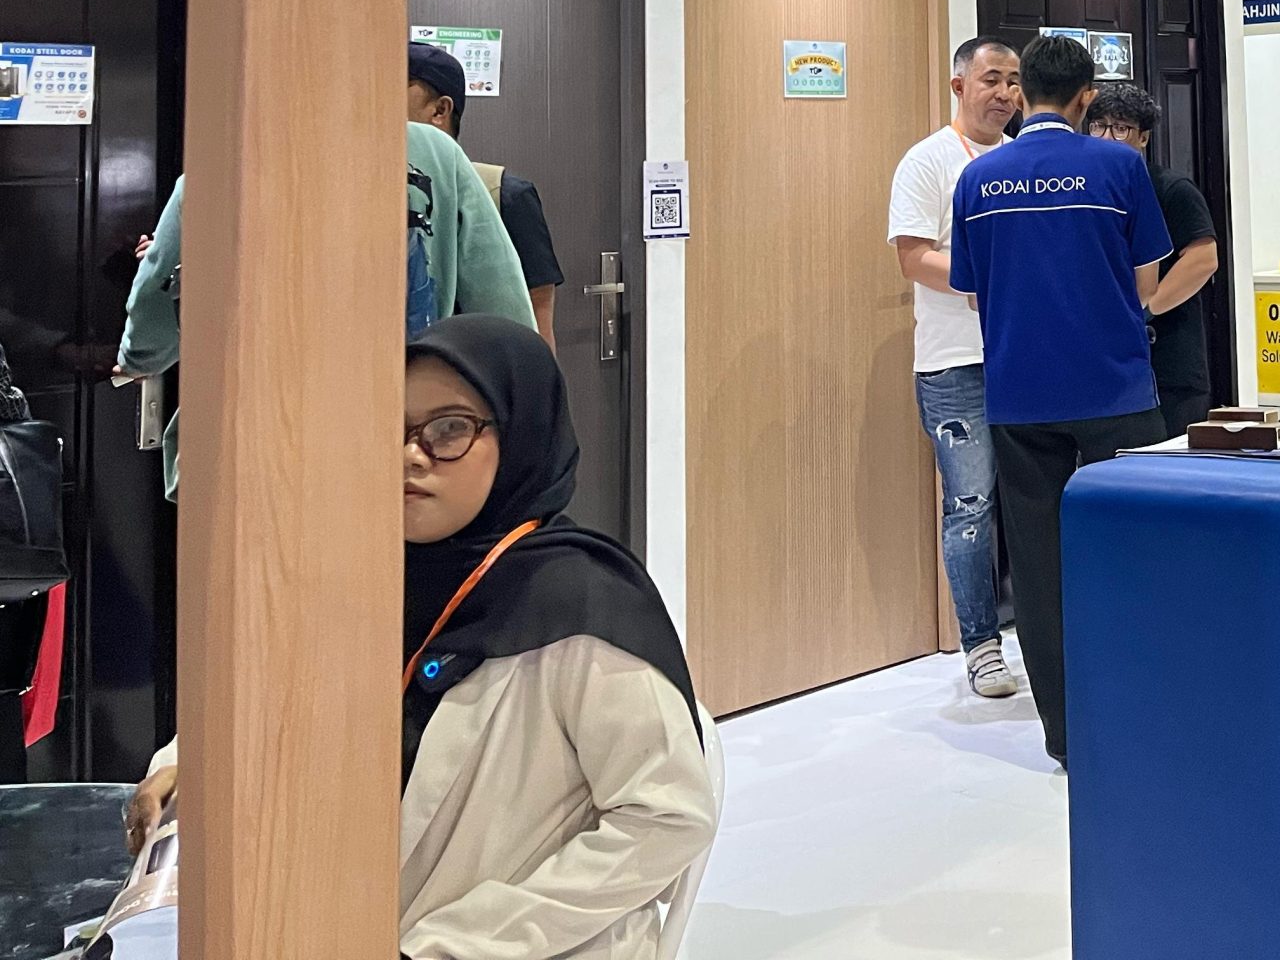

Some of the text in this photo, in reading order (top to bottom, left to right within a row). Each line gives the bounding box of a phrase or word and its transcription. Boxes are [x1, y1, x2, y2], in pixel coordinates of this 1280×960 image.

[1242, 2, 1280, 19] AHJIN
[438, 30, 482, 38] ENGINEERING
[795, 56, 838, 67] NEW PRODUCT
[981, 176, 1086, 198] KODAI DOOR
